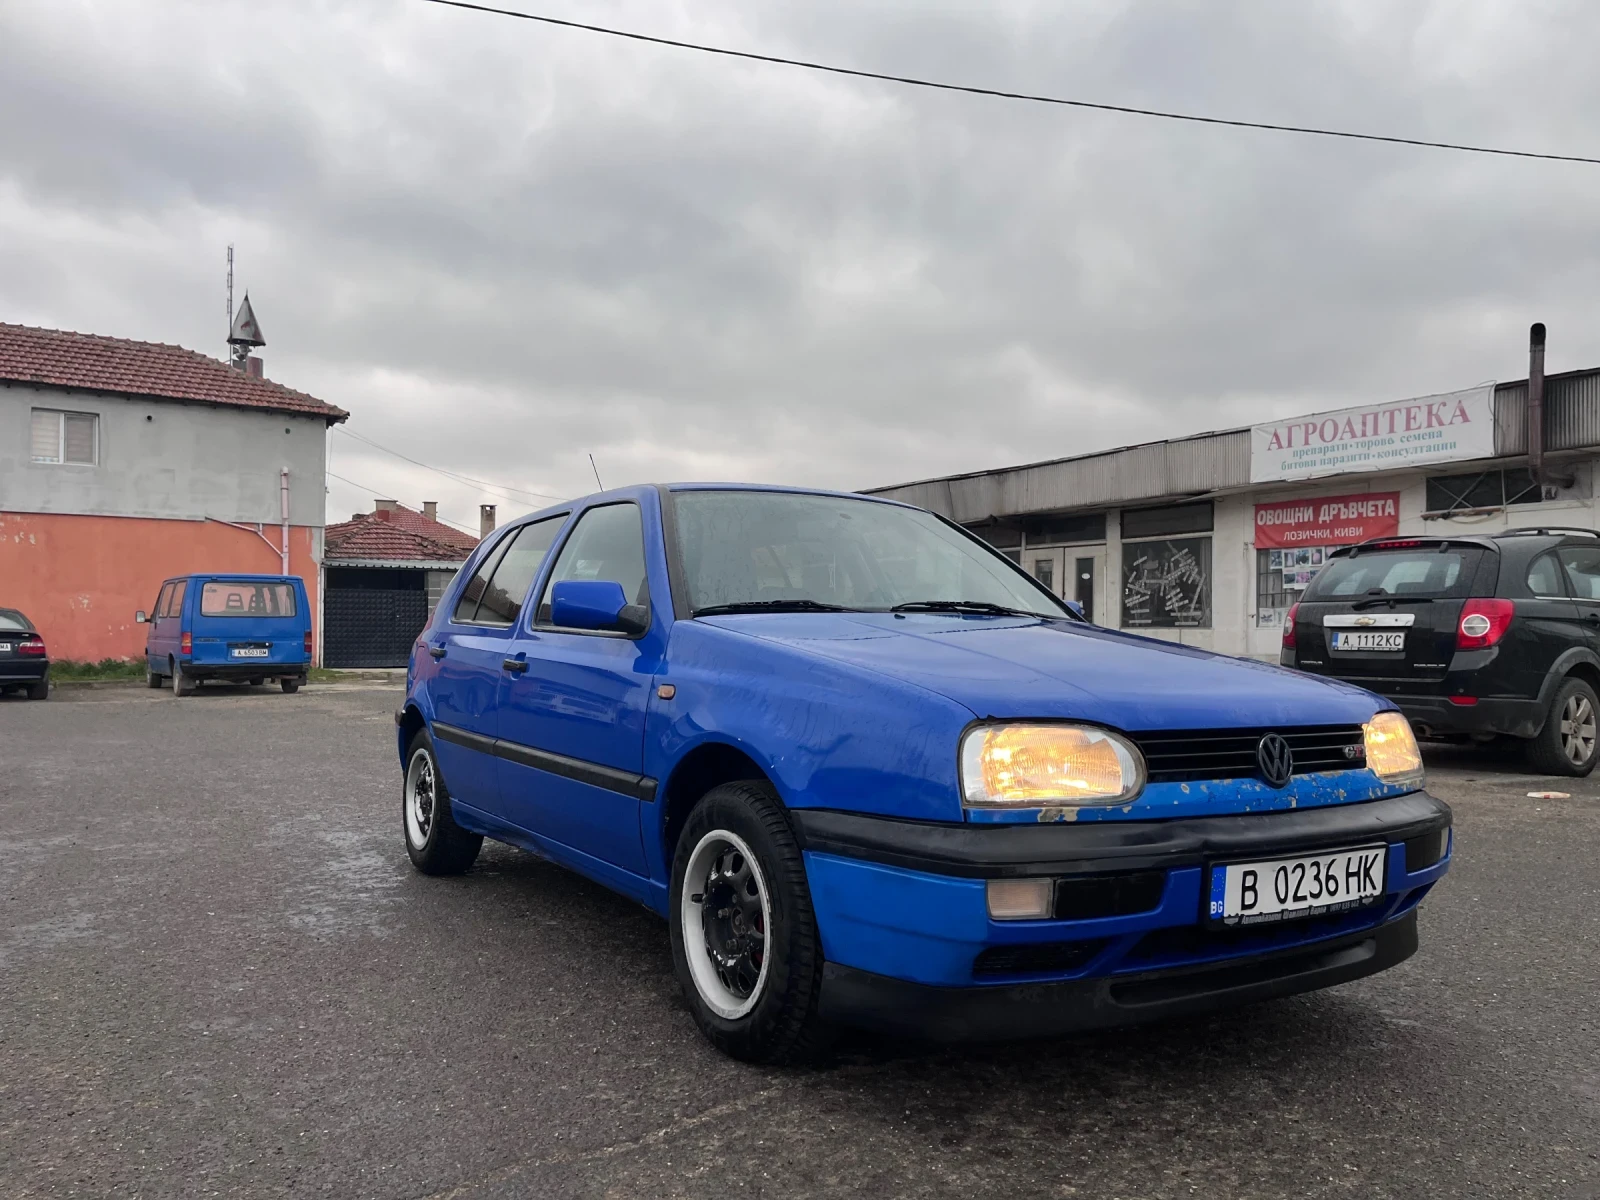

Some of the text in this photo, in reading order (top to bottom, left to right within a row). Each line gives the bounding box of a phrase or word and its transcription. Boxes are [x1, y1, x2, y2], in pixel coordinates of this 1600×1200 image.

[1267, 400, 1471, 450] АГРОАПТЕКА
[1400, 430, 1443, 444] семена
[1281, 459, 1316, 471] битови
[1377, 442, 1457, 459] консултации
[1257, 499, 1395, 526] ОВОЩНИ ДРЪВЧЕТА
[1283, 527, 1363, 541] ЛОЗИЧКИ, КИВИ
[1241, 870, 1258, 911] B
[1210, 900, 1223, 914] BG
